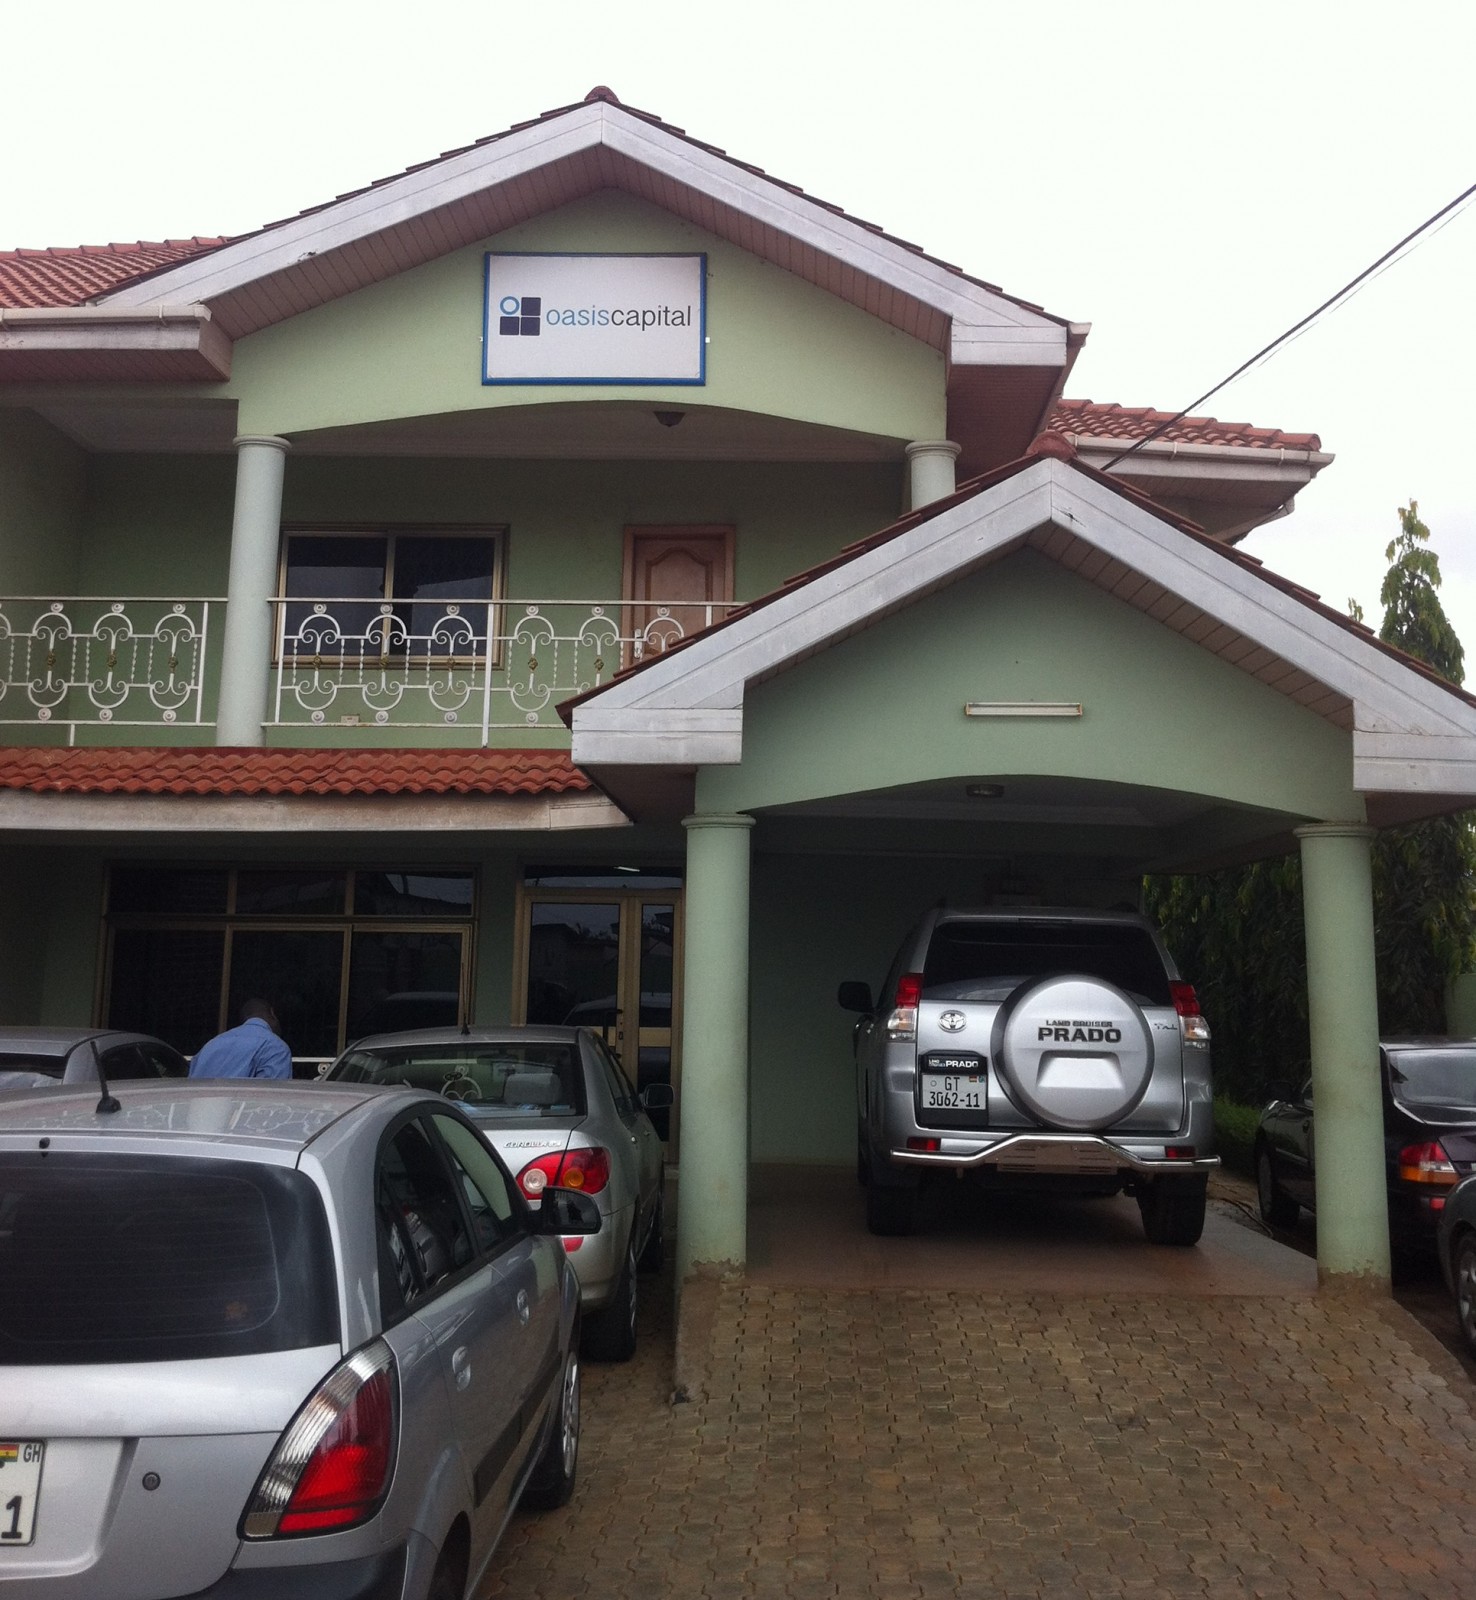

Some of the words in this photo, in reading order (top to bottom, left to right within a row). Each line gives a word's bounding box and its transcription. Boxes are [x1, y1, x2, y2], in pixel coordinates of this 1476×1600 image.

[546, 305, 691, 331] oasiscapital
[1072, 1020, 1113, 1028] CRUISER
[1038, 1027, 1122, 1043] PRADO
[945, 1060, 979, 1068] PRADO
[944, 1076, 960, 1091] GT
[929, 1091, 980, 1108] 3062-11
[23, 1443, 42, 1463] GH
